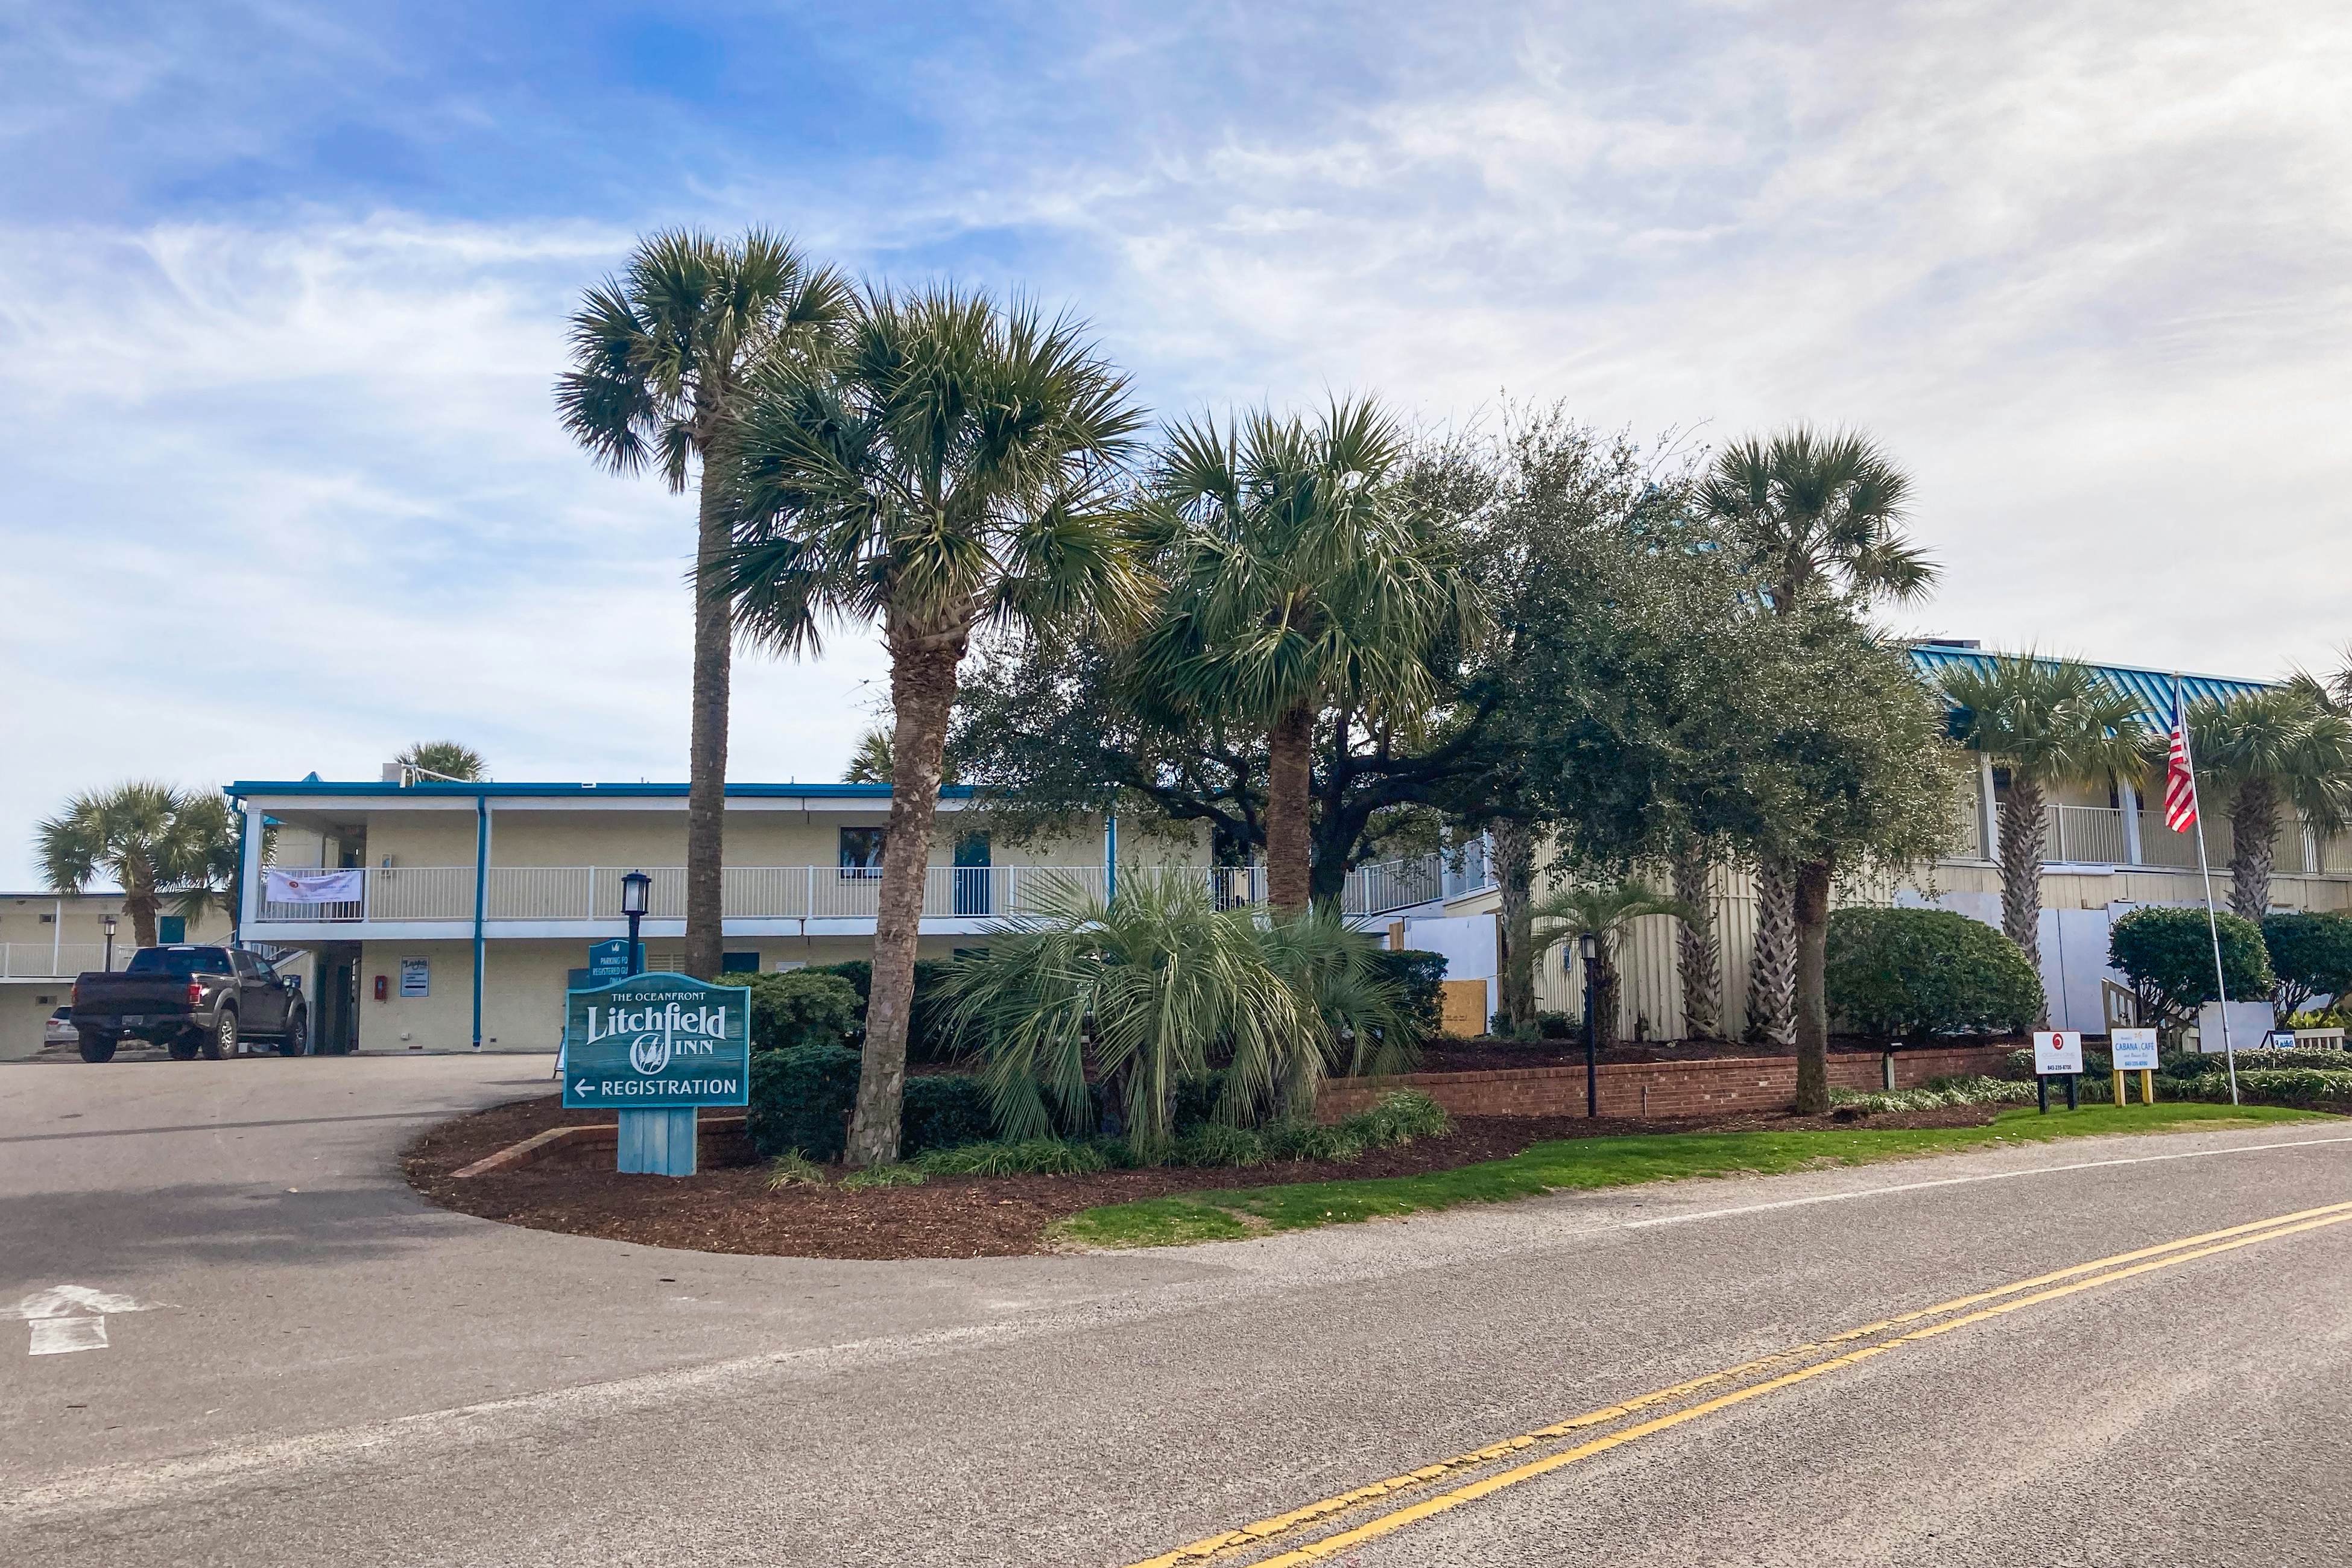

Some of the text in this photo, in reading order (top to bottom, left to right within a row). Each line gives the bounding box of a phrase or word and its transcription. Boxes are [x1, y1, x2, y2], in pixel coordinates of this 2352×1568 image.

[593, 967, 620, 975] REGISTERED
[612, 992, 706, 1002] THE OCEANFRONT
[587, 1002, 727, 1075] Litchfield
[675, 1040, 713, 1055] INN
[2115, 1042, 2138, 1051] CABANA
[601, 1080, 736, 1096] REGISTRATION
